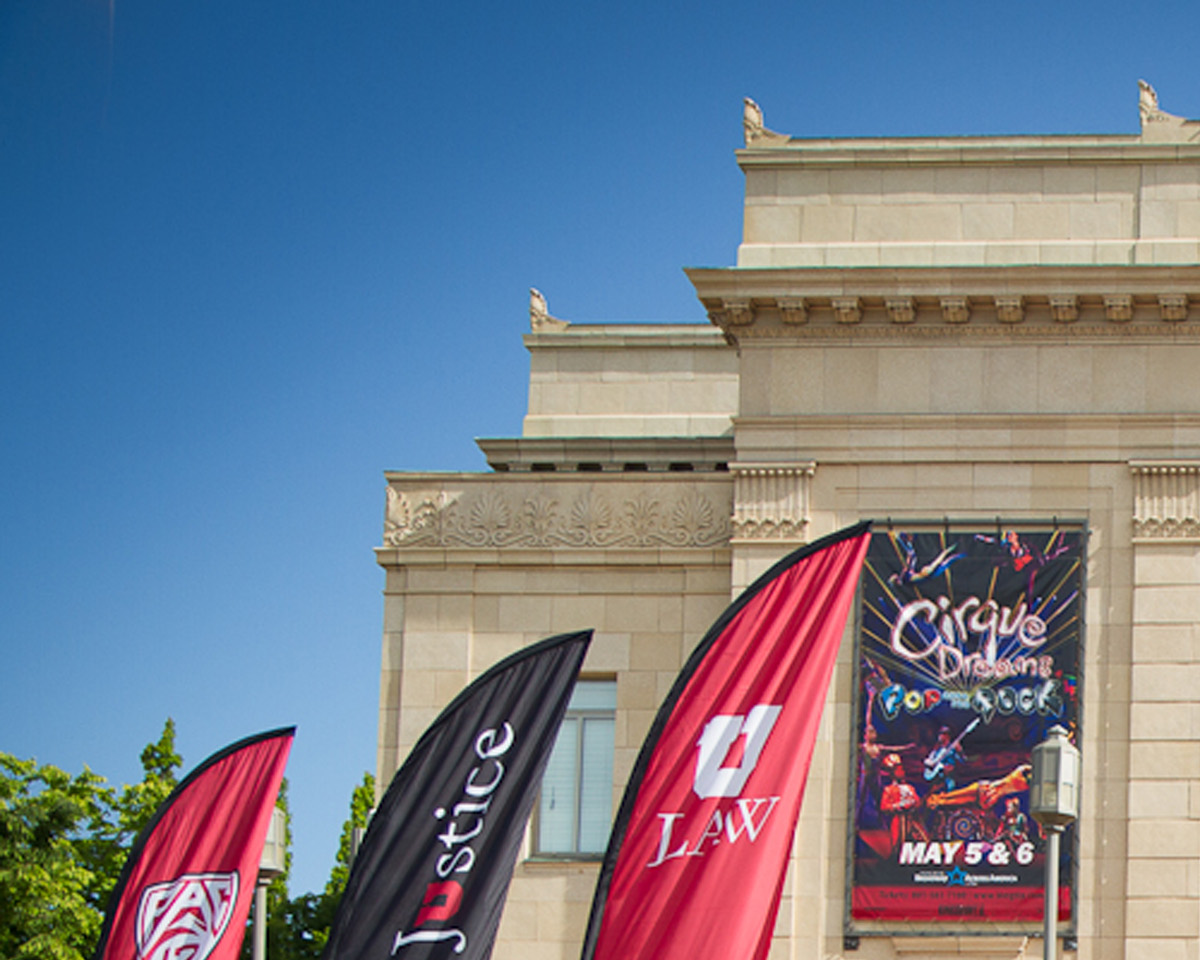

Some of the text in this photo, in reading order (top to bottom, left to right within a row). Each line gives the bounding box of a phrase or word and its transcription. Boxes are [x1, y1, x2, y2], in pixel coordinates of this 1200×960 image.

[891, 596, 1048, 667] Cirque
[938, 645, 1054, 681] Dreams
[647, 797, 780, 867] LAW
[899, 841, 1035, 865] MAY 5 & 6
